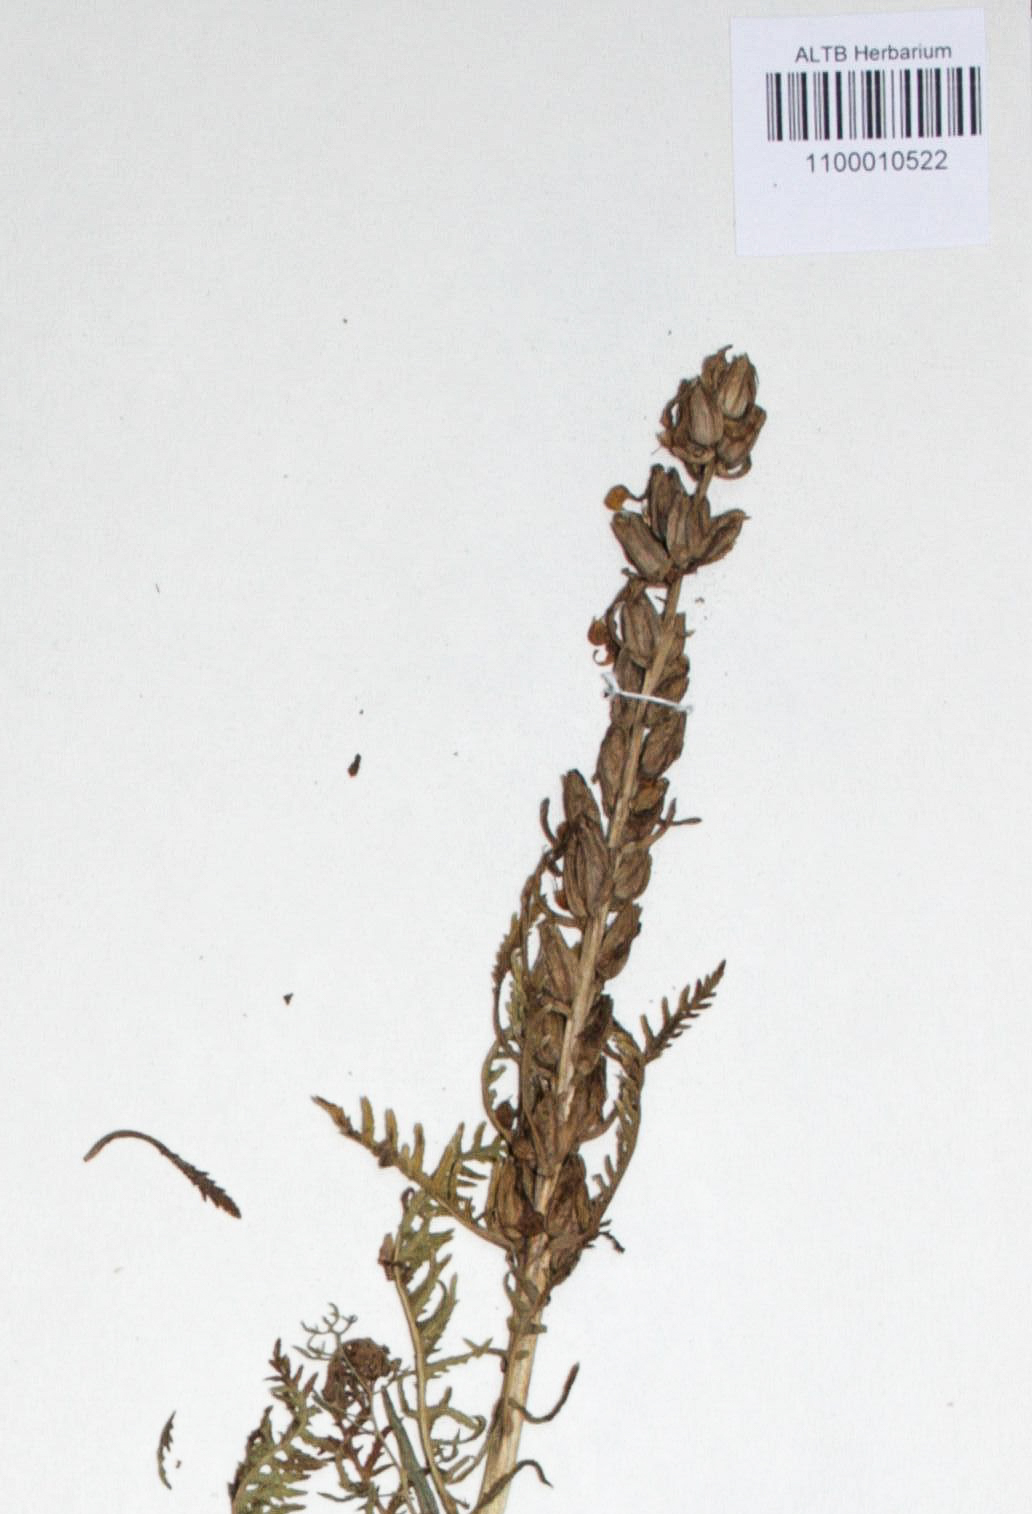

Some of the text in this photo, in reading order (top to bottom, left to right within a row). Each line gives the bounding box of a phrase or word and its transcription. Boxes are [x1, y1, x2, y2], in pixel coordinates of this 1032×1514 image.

[795, 44, 952, 63] ALTB Herbarium
[806, 149, 948, 173] 1100010522
